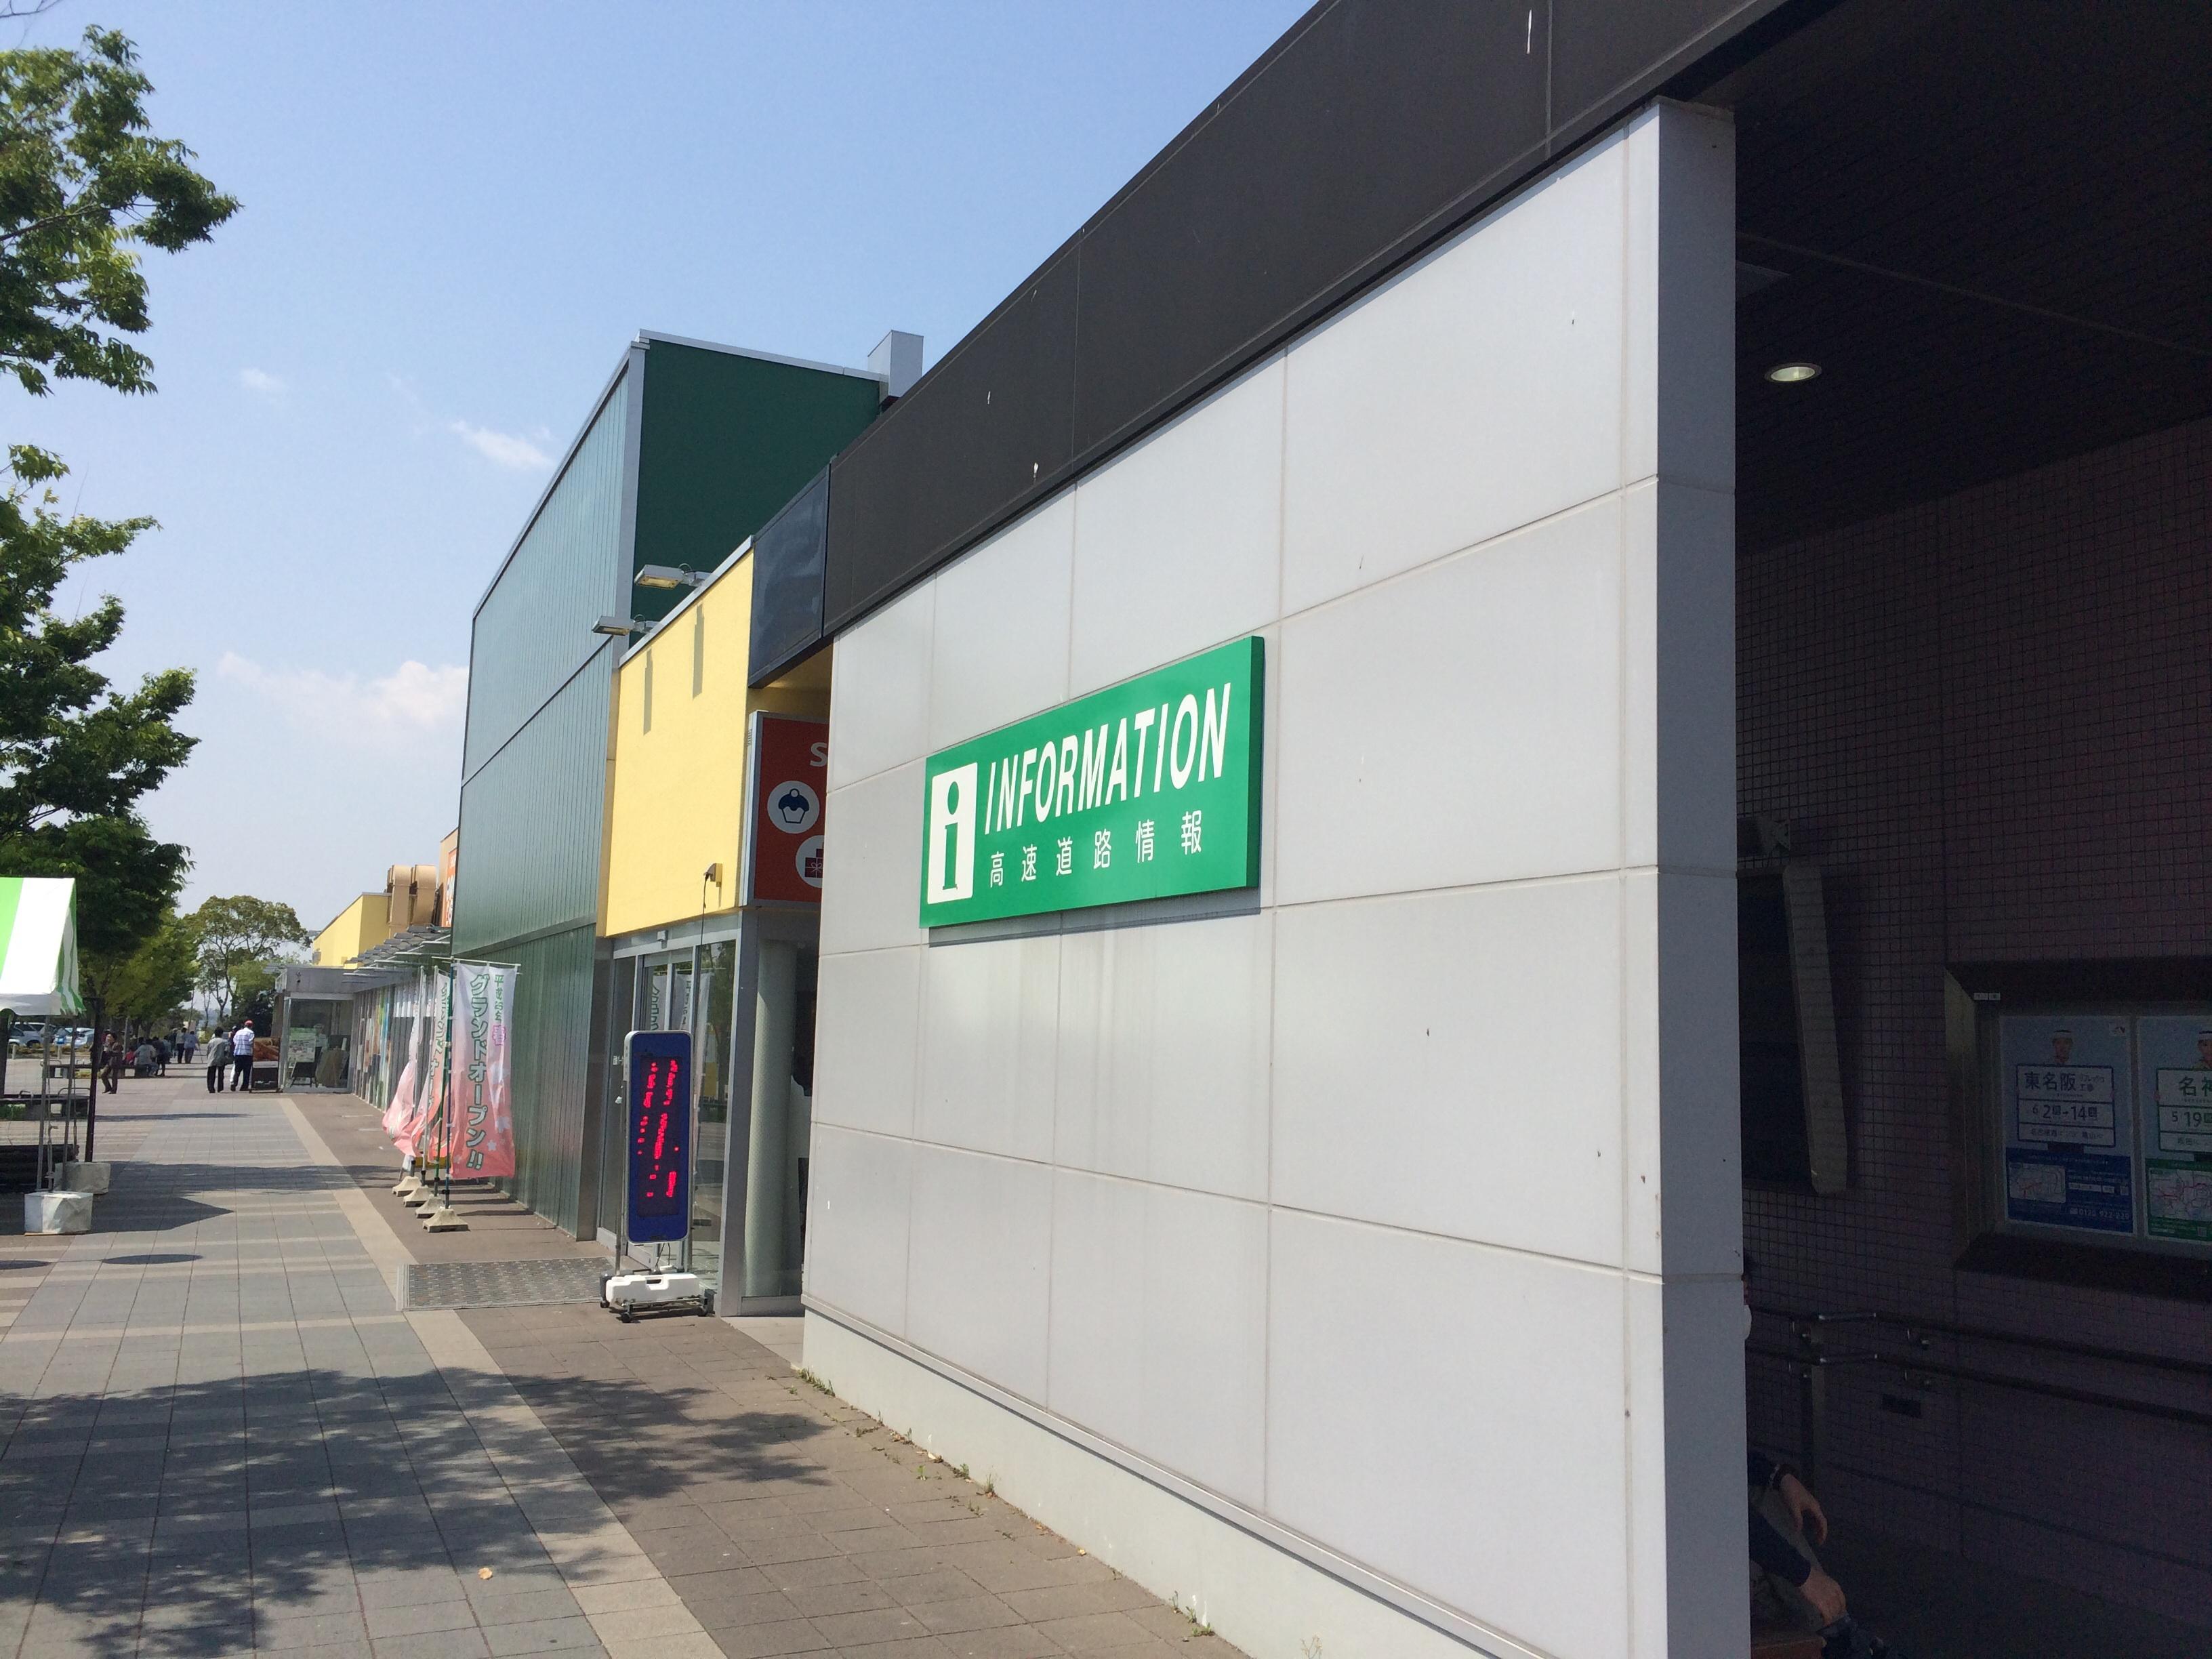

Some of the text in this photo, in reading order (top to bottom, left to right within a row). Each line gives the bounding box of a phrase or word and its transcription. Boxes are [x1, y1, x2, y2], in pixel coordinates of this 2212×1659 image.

[985, 682, 1231, 834] INFORMATION
[989, 810, 1202, 888] 高速道路情報
[2024, 1071, 2076, 1091] 東名阪
